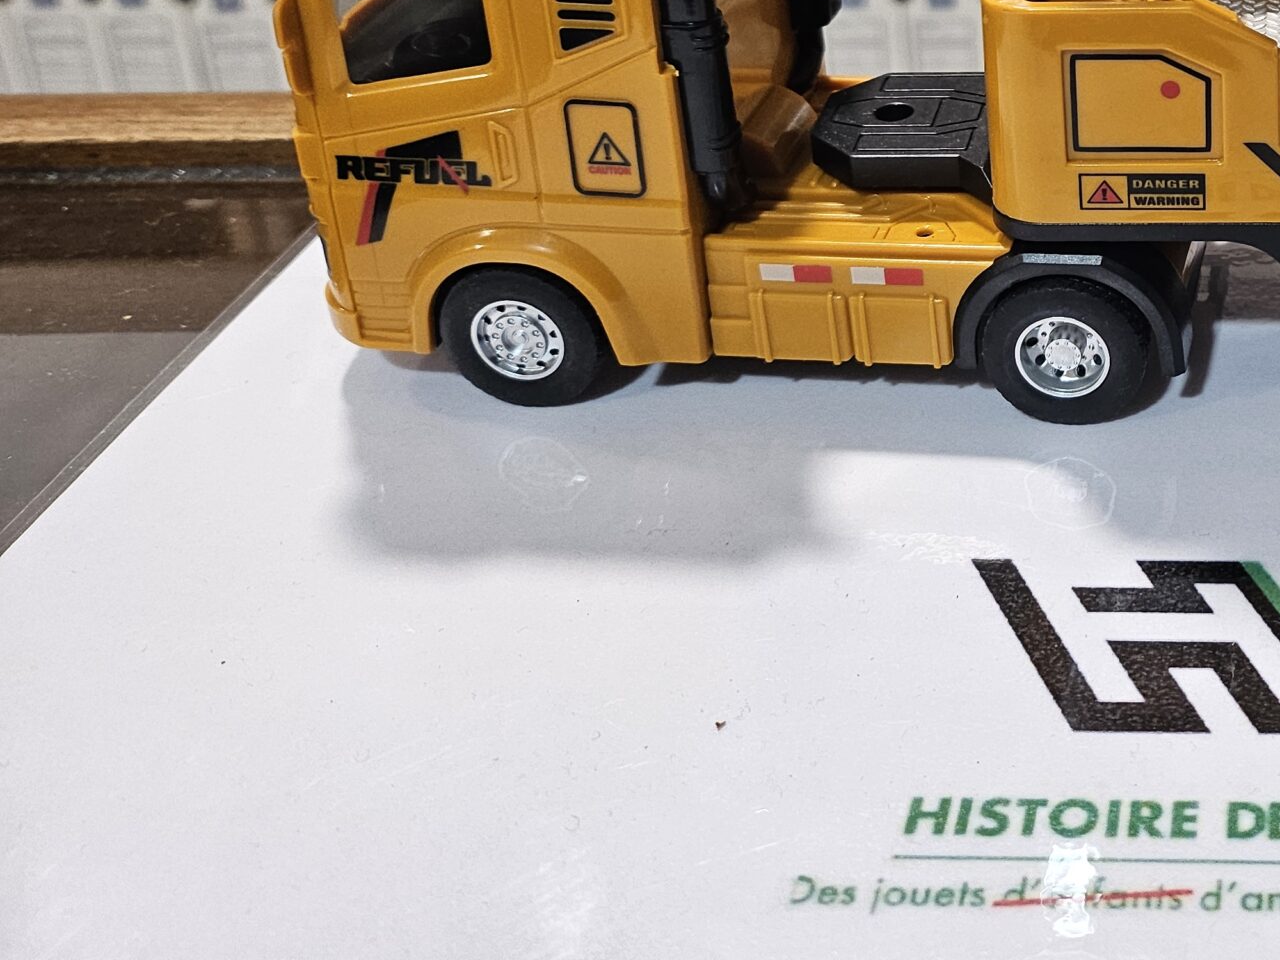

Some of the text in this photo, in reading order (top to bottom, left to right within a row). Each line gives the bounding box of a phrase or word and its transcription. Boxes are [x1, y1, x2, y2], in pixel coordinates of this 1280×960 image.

[335, 155, 493, 188] REFUEL
[588, 165, 632, 176] CAUTION
[1131, 179, 1200, 190] DANGER
[1133, 195, 1201, 207] WARNING
[903, 796, 1200, 840] HISTOIRE
[789, 875, 858, 906] Des
[869, 877, 986, 915] jouets
